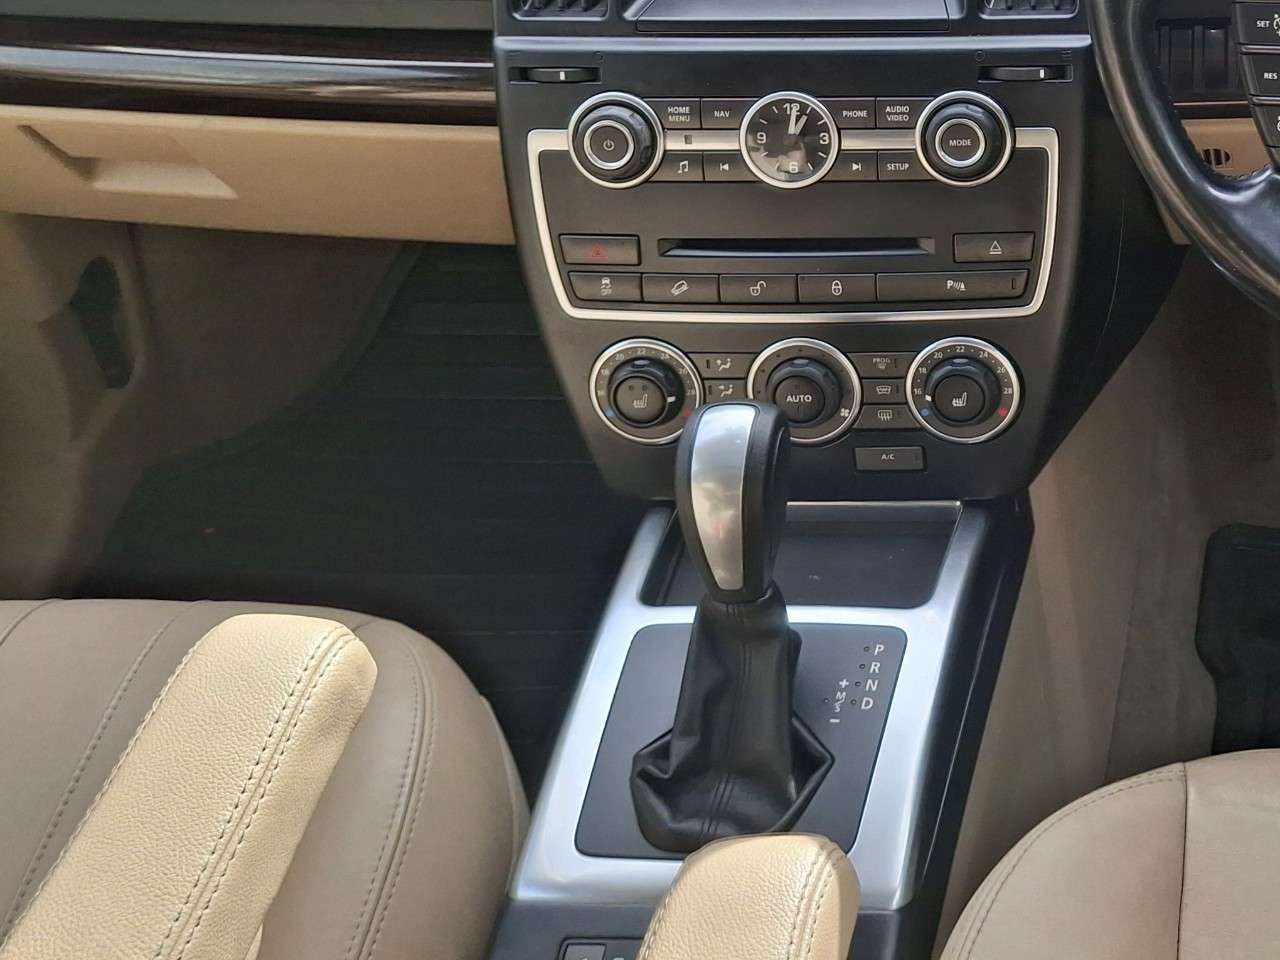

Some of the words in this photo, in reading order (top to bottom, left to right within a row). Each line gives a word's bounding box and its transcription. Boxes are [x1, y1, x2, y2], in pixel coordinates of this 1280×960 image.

[1256, 19, 1270, 28] SET
[1263, 72, 1278, 80] RES
[667, 106, 691, 114] HOME
[783, 102, 801, 115] 12
[885, 105, 910, 113] AUDIO
[714, 110, 730, 118] NAV
[842, 110, 868, 118] PHONE
[886, 114, 910, 122] VIDEO
[756, 131, 767, 144] 9
[819, 132, 830, 145] 3
[949, 139, 972, 147] MODE
[789, 161, 799, 174] 6
[886, 163, 910, 171] SETUP
[933, 351, 944, 359] 20
[919, 366, 928, 374] 18
[996, 366, 1006, 374] 26
[913, 388, 923, 396] 16
[1003, 387, 1013, 395] 28
[786, 394, 813, 403] AUTO
[874, 644, 885, 656] P
[870, 661, 881, 674] R
[865, 679, 878, 692] N
[861, 697, 874, 710] D
